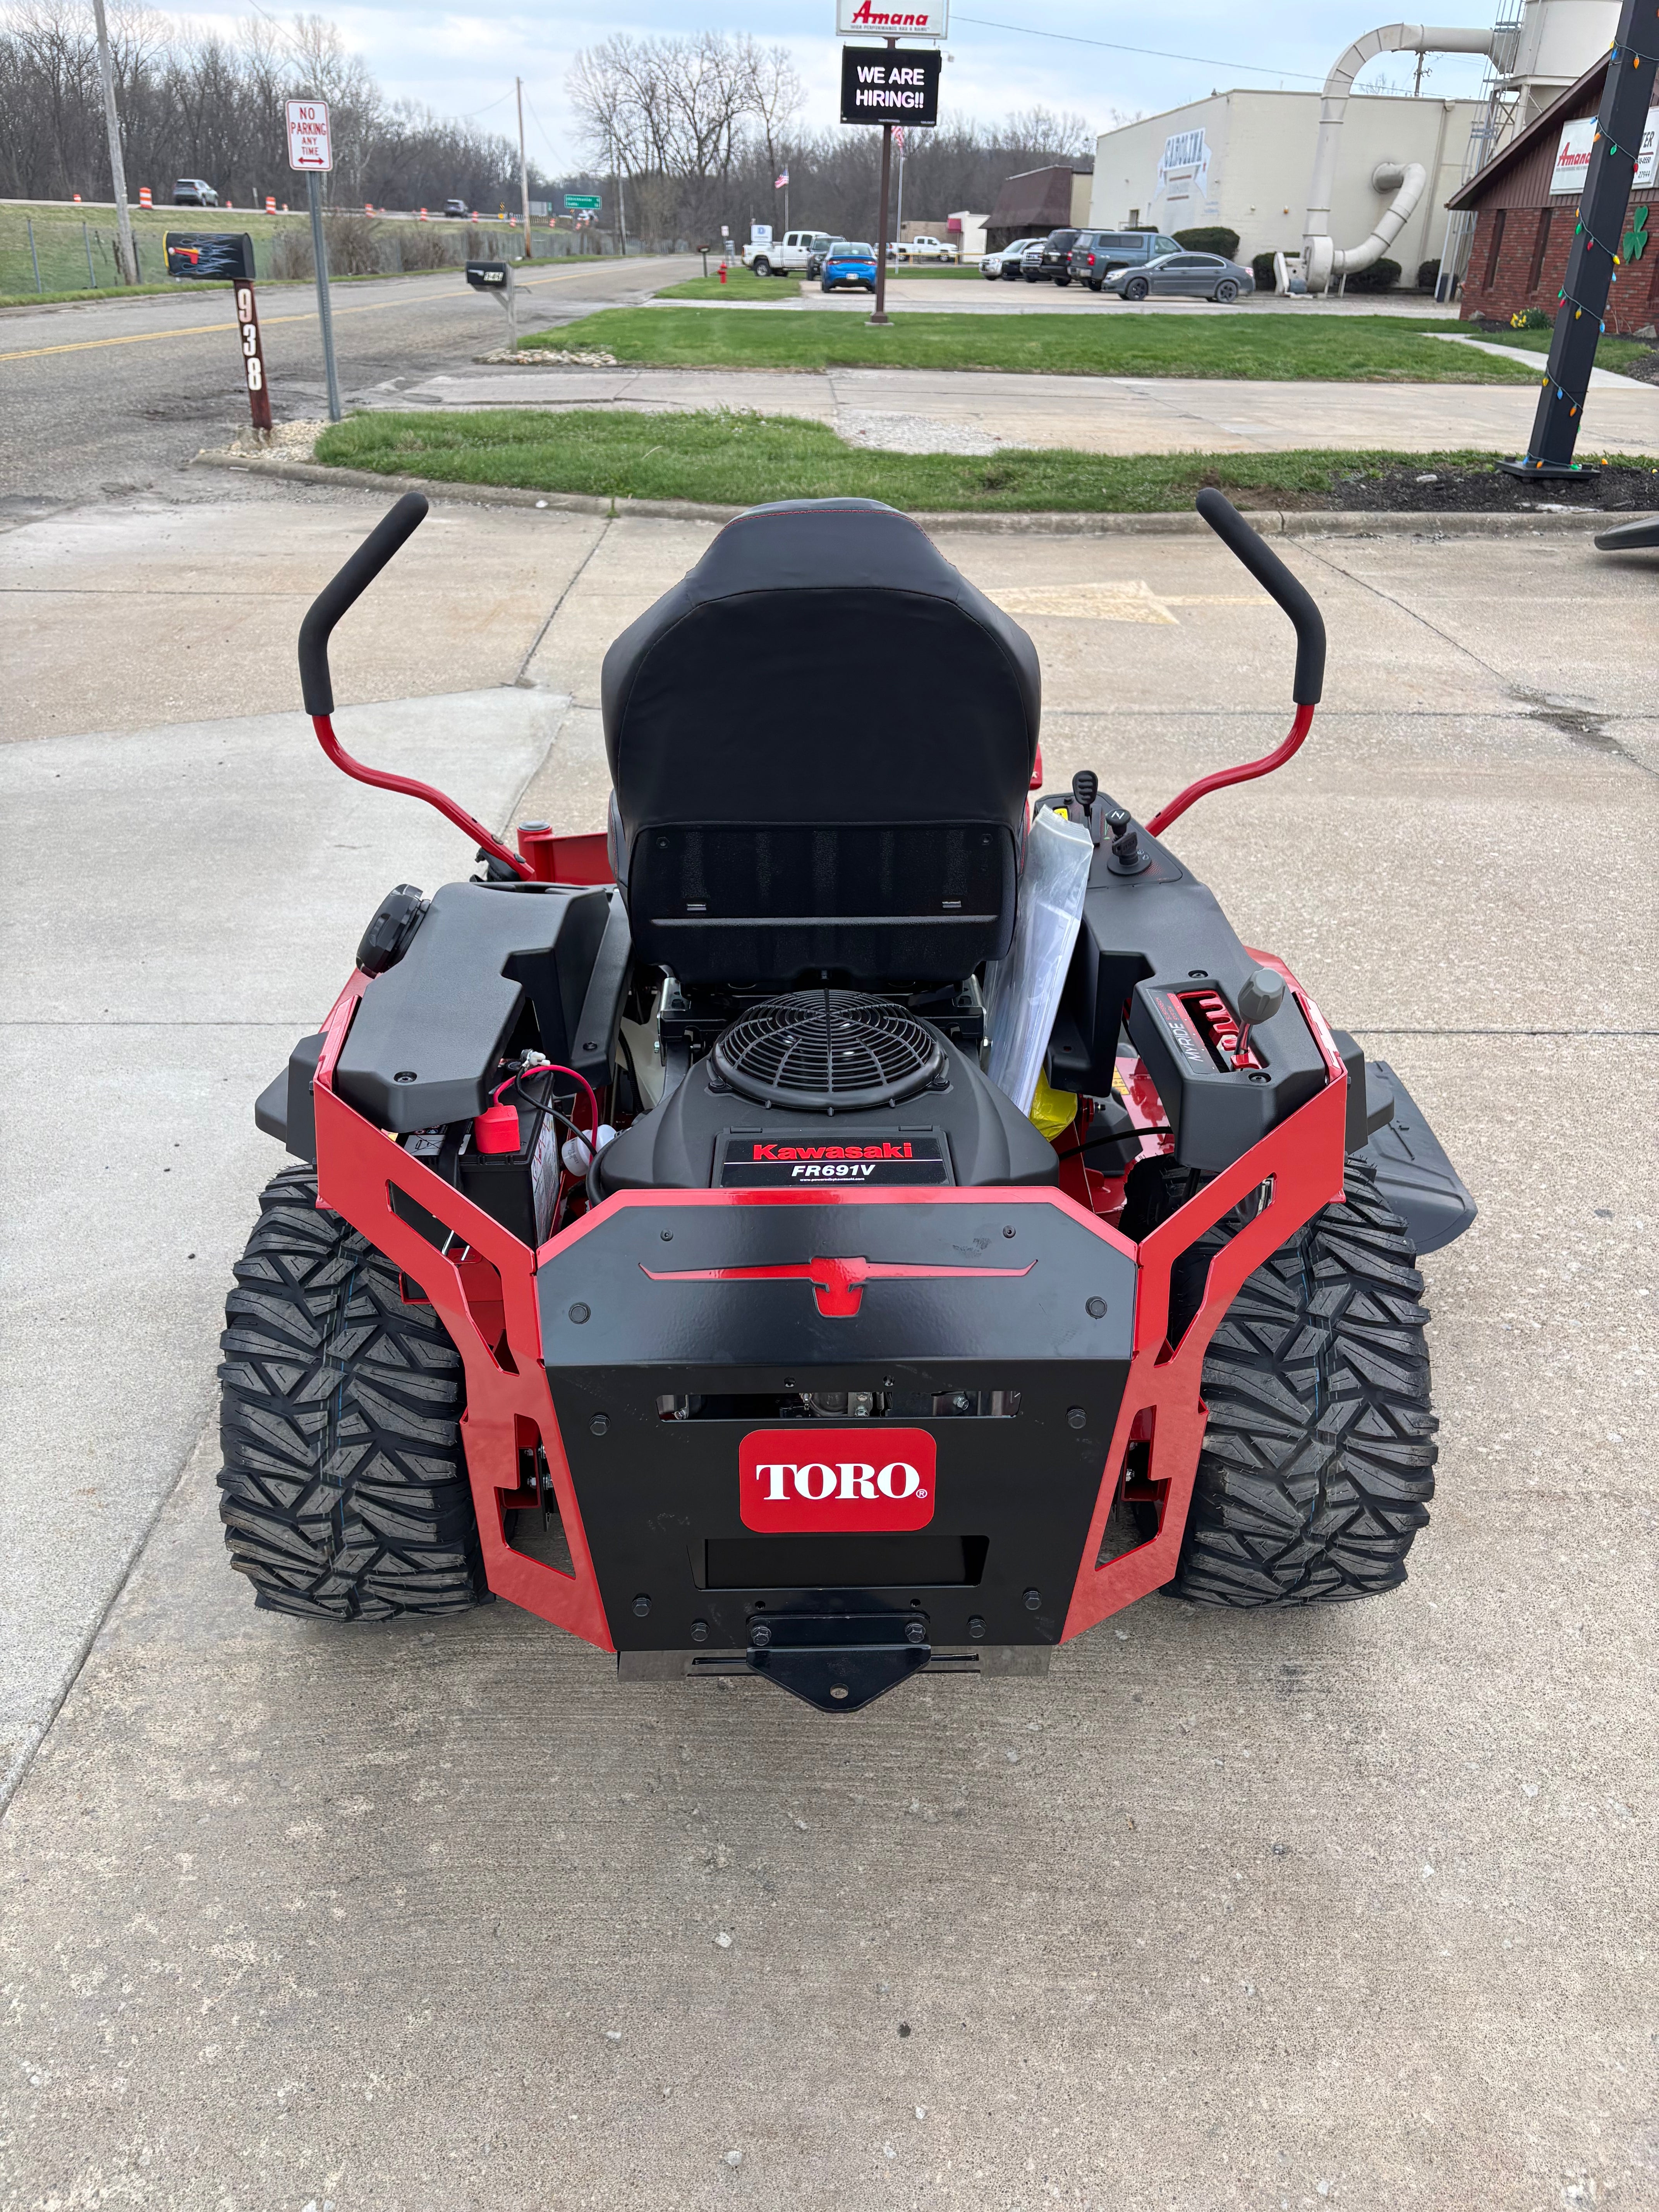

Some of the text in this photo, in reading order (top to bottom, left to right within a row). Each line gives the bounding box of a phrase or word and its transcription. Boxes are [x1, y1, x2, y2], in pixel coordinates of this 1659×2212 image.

[851, 0, 929, 26] Amana
[857, 66, 924, 85] WE ARE
[856, 89, 924, 108] HIRING!!
[299, 107, 315, 120] NO
[290, 122, 326, 136] PARKING
[302, 137, 317, 146] ANY
[301, 147, 319, 156] TIME
[237, 289, 262, 390] 938
[753, 1143, 913, 1160] Kawasaki
[791, 1164, 875, 1176] FR691V
